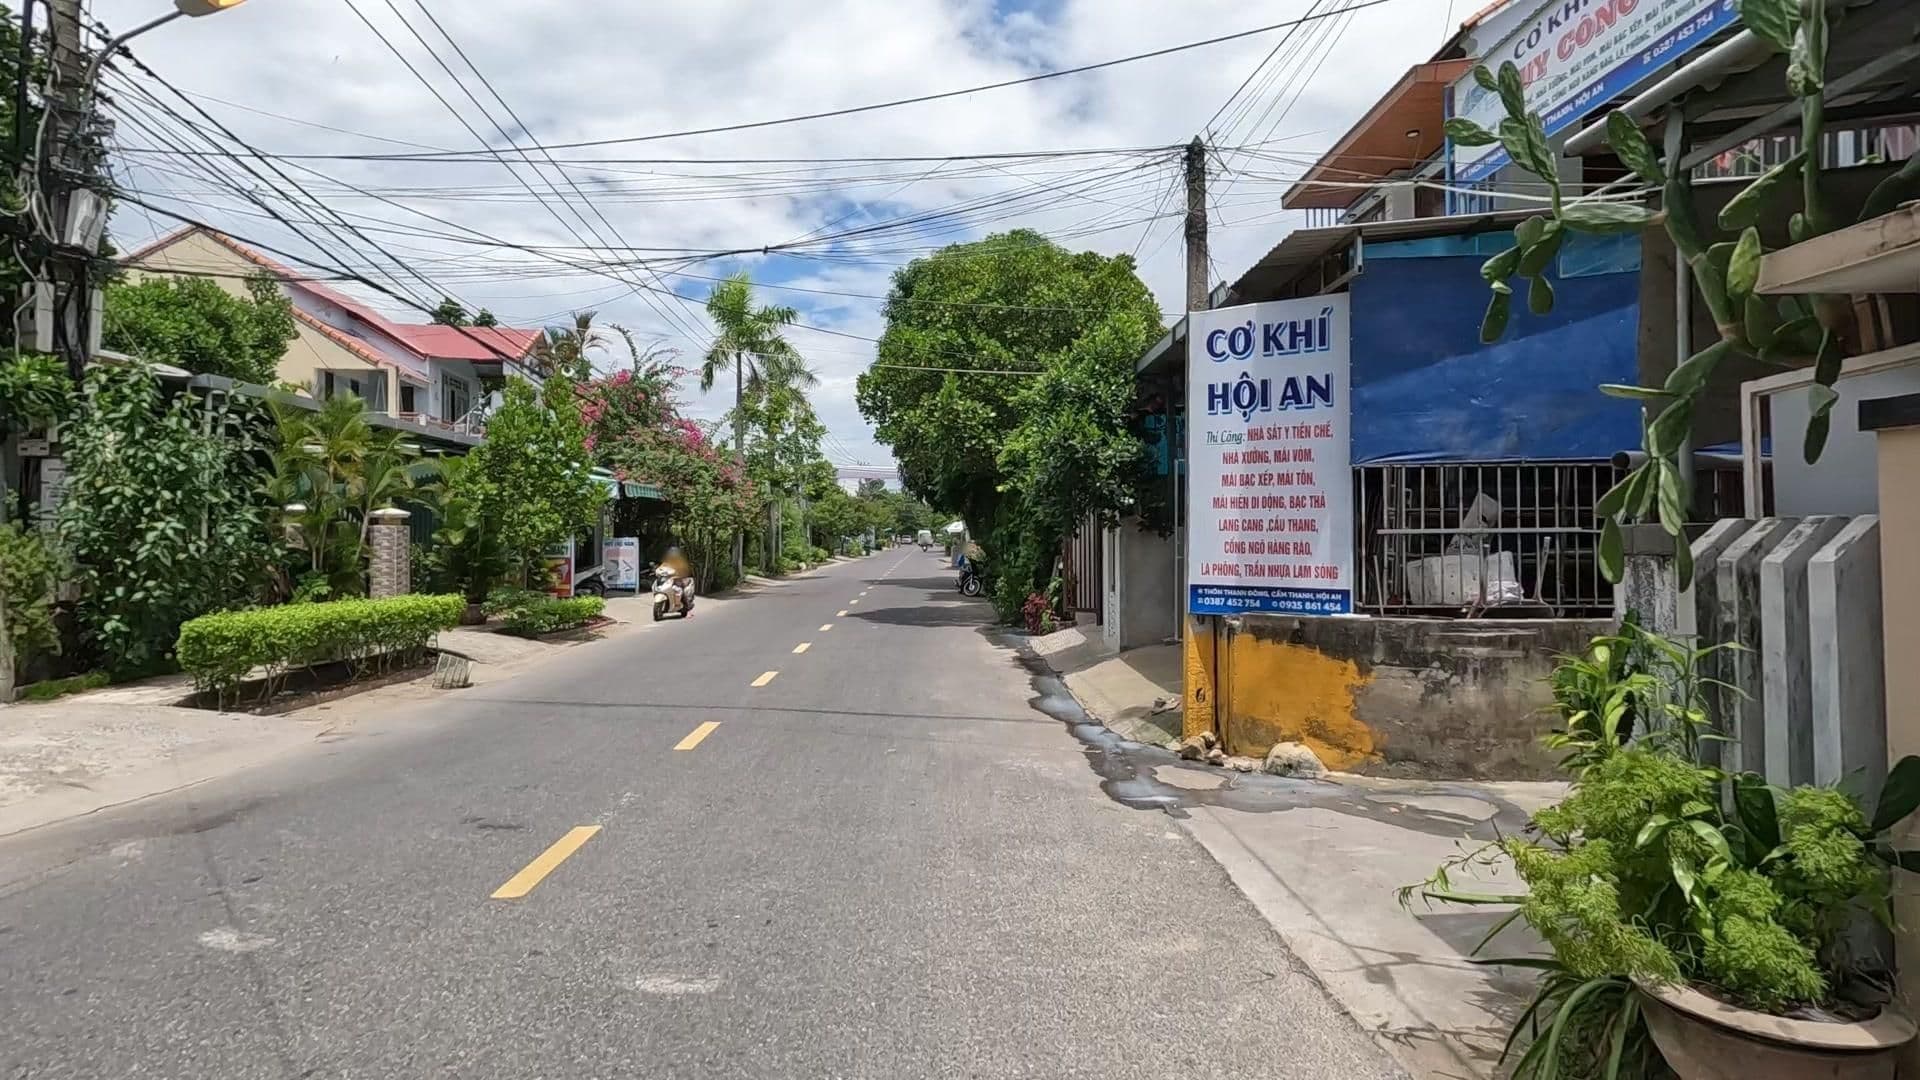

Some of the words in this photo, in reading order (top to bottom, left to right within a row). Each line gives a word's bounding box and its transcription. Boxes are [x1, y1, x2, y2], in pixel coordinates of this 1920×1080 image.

[1677, 23, 1695, 41] 452
[1697, 9, 1714, 29] 754
[1514, 21, 1541, 59] CƠ
[1591, 82, 1604, 98] AN
[1207, 320, 1256, 362] CƠ
[1263, 305, 1334, 357] KHÍ
[1208, 371, 1272, 423] HỘI
[1278, 372, 1334, 411] AN
[1247, 426, 1265, 442] NHÀ
[1284, 426, 1290, 440] Y
[1222, 450, 1239, 465] NHÀ
[1274, 446, 1290, 463] MÁI
[1221, 472, 1237, 487] MÁI
[1240, 474, 1256, 489] BẠC
[1277, 470, 1294, 486] MÁI
[1213, 493, 1228, 509] MÁI
[1251, 495, 1260, 509] DI
[1289, 495, 1307, 512] BẠC
[1218, 519, 1239, 532] LANG
[1241, 519, 1264, 532] CANG
[1288, 519, 1319, 533] THANG,
[1267, 539, 1290, 555] HÀNG
[1201, 562, 1210, 576] LA
[1267, 563, 1291, 580] NHỰA
[1293, 565, 1312, 579] LAM
[1204, 597, 1225, 605] 0387
[1226, 598, 1243, 606] 452
[1244, 599, 1261, 607] 754
[1279, 602, 1303, 610] 0935
[1304, 602, 1321, 610] 861
[1323, 603, 1342, 611] 454
